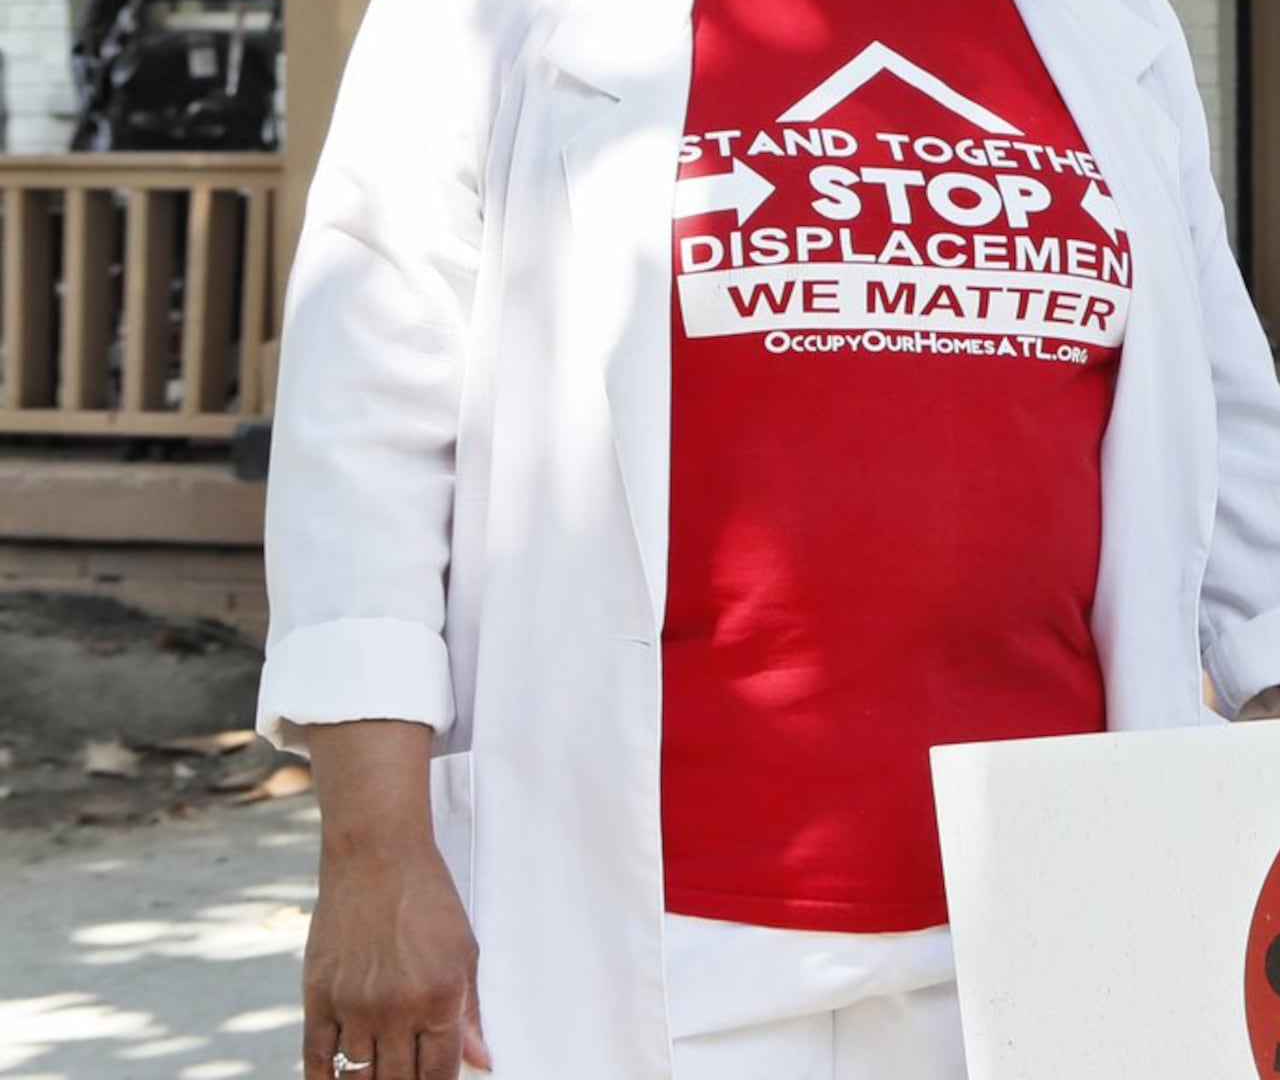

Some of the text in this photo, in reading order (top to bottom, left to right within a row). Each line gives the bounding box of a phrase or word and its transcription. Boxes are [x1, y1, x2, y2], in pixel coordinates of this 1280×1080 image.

[678, 128, 1104, 181] STAND TOGETHE
[808, 165, 1052, 229] STOP
[680, 226, 1130, 286] DISPLACEMEN
[727, 280, 1116, 331] WE MATTER
